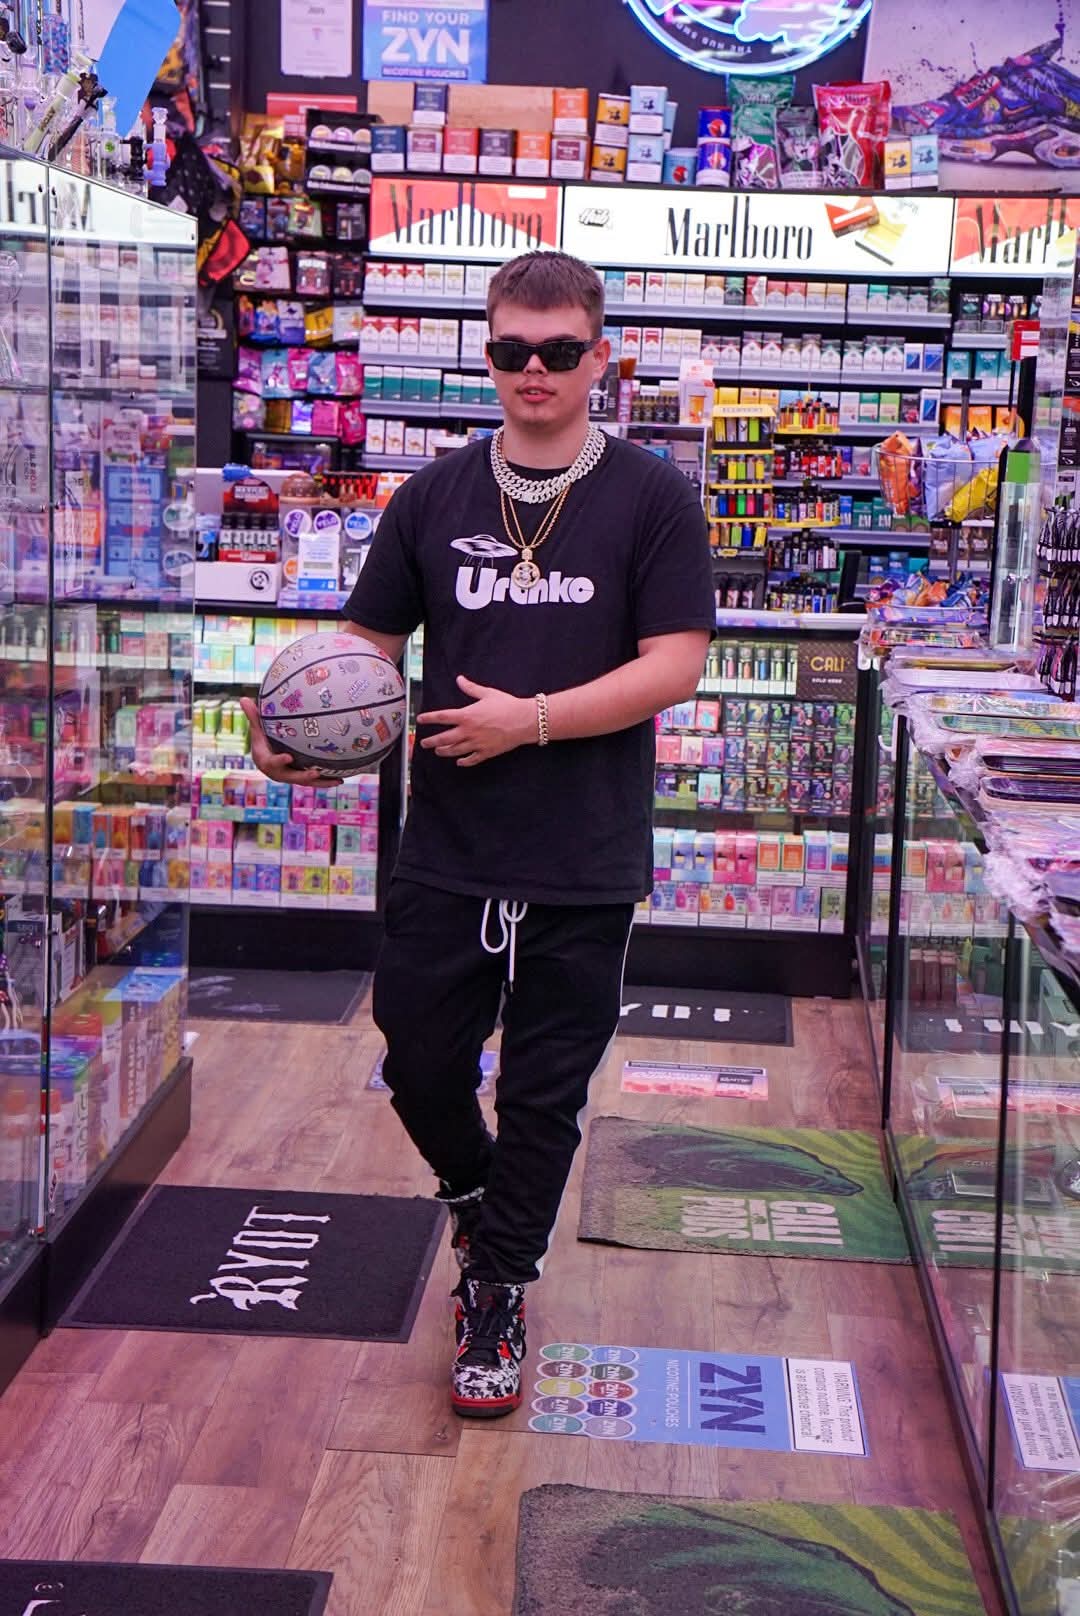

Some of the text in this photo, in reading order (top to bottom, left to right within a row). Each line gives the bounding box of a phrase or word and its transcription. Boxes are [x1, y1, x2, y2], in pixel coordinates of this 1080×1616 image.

[382, 26, 470, 64] ZYN
[383, 10, 470, 25] FIND YOUR
[389, 182, 542, 249] Marlboro
[664, 195, 813, 260] Marlboro
[810, 656, 845, 672] CALI
[190, 1206, 331, 1311] RYOT
[665, 1360, 681, 1428] NICOTINE POUCHES
[700, 1362, 766, 1433] ZYN
[836, 1418, 855, 1442] product
